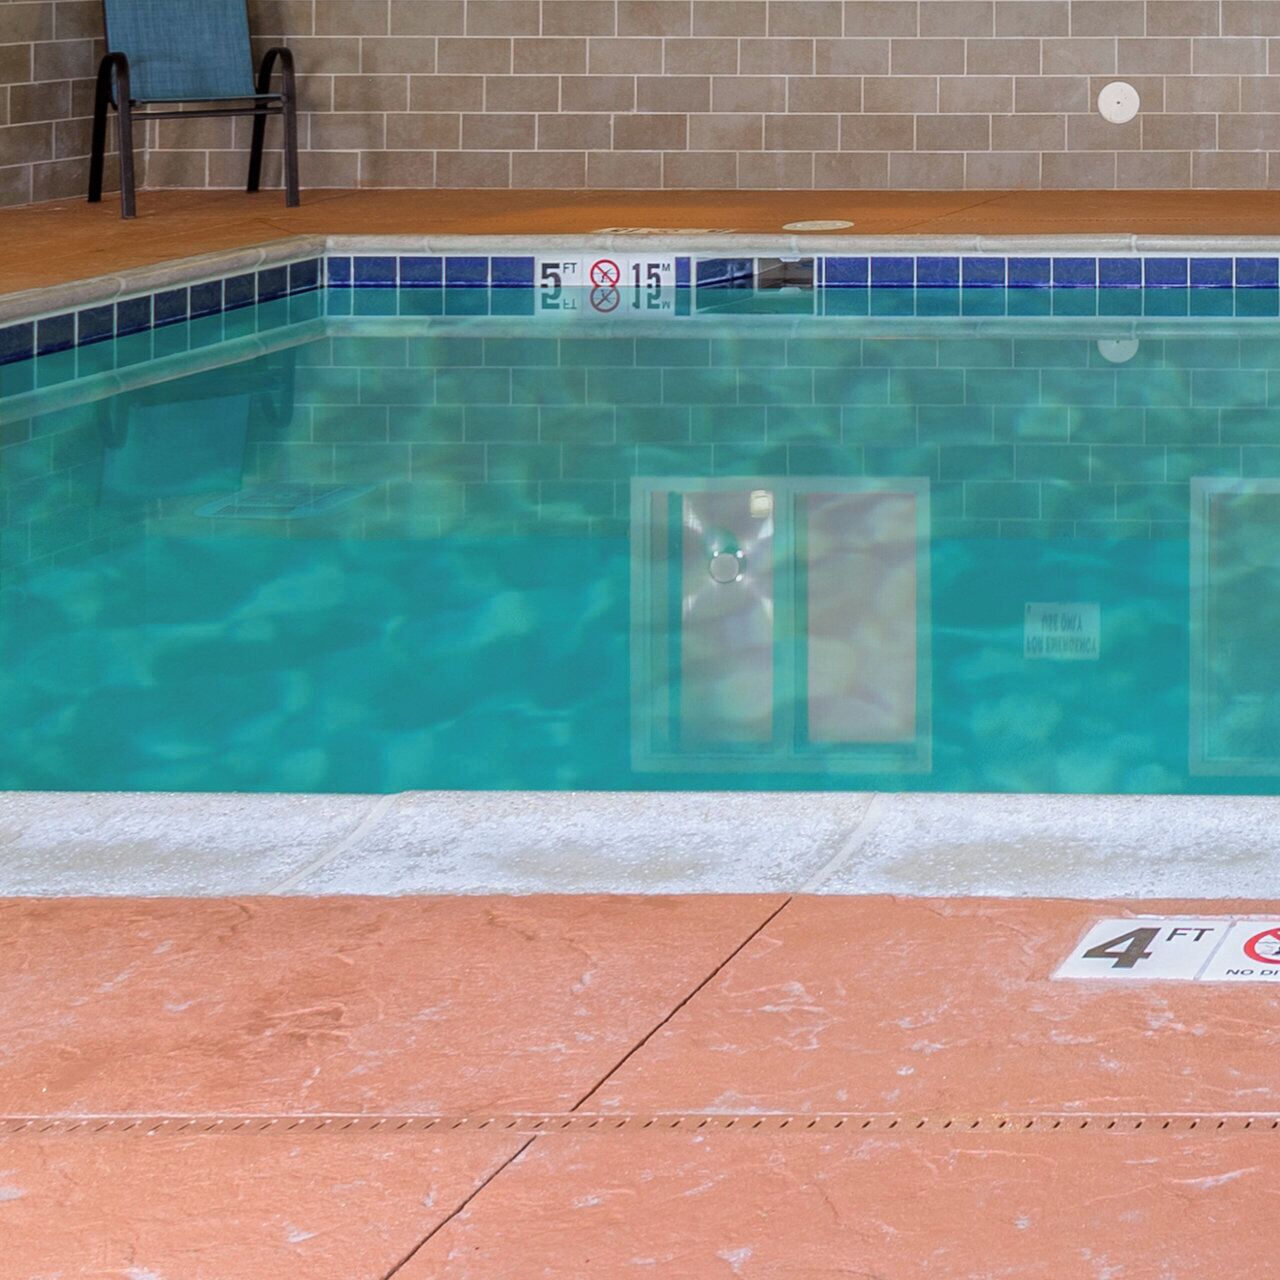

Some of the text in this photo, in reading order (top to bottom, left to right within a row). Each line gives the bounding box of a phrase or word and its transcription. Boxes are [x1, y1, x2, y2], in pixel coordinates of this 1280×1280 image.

[540, 262, 561, 288] 5
[563, 262, 578, 274] FT
[661, 262, 671, 272] M
[1082, 927, 1161, 969] 4
[1165, 927, 1215, 943] FT
[1225, 968, 1255, 977] NO
